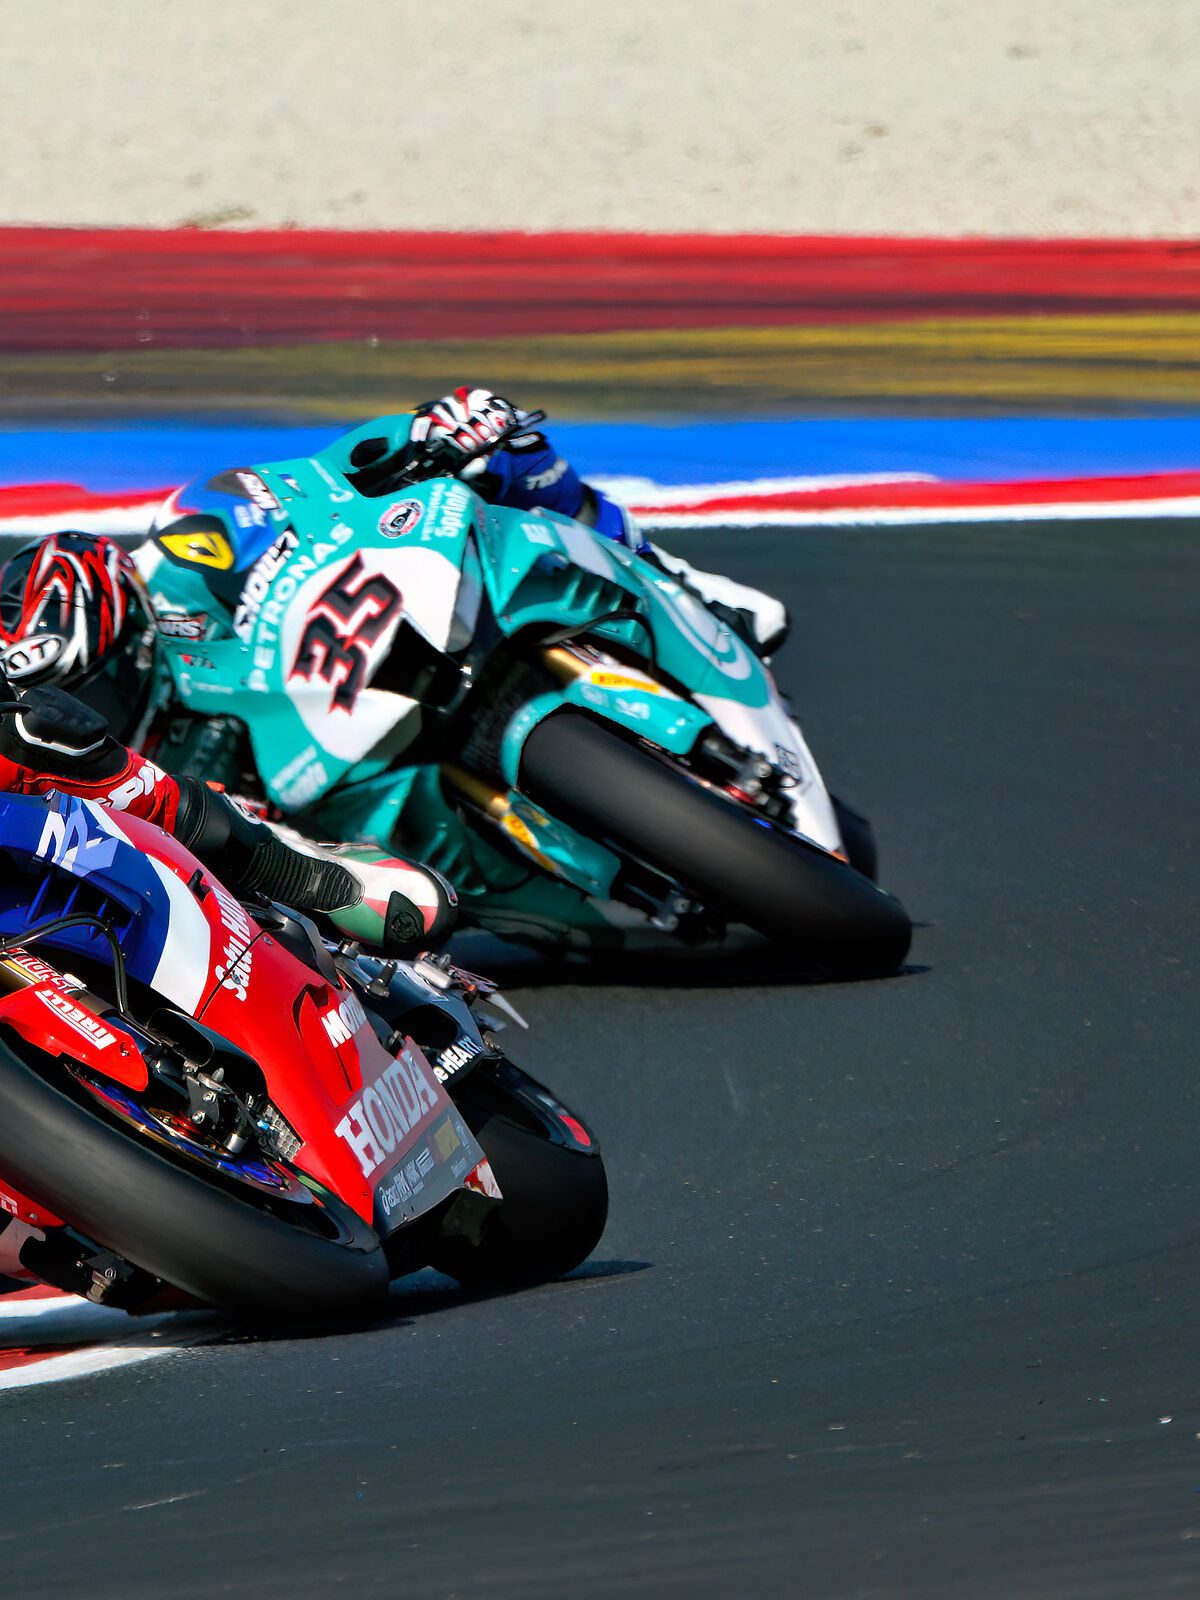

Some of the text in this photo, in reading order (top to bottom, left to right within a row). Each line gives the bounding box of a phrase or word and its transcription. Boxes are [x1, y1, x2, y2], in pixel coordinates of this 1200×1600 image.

[249, 526, 355, 692] PETRONAS
[288, 550, 403, 715] 35
[34, 989, 117, 1050] PIRELLI
[334, 1049, 439, 1179] HONDA
